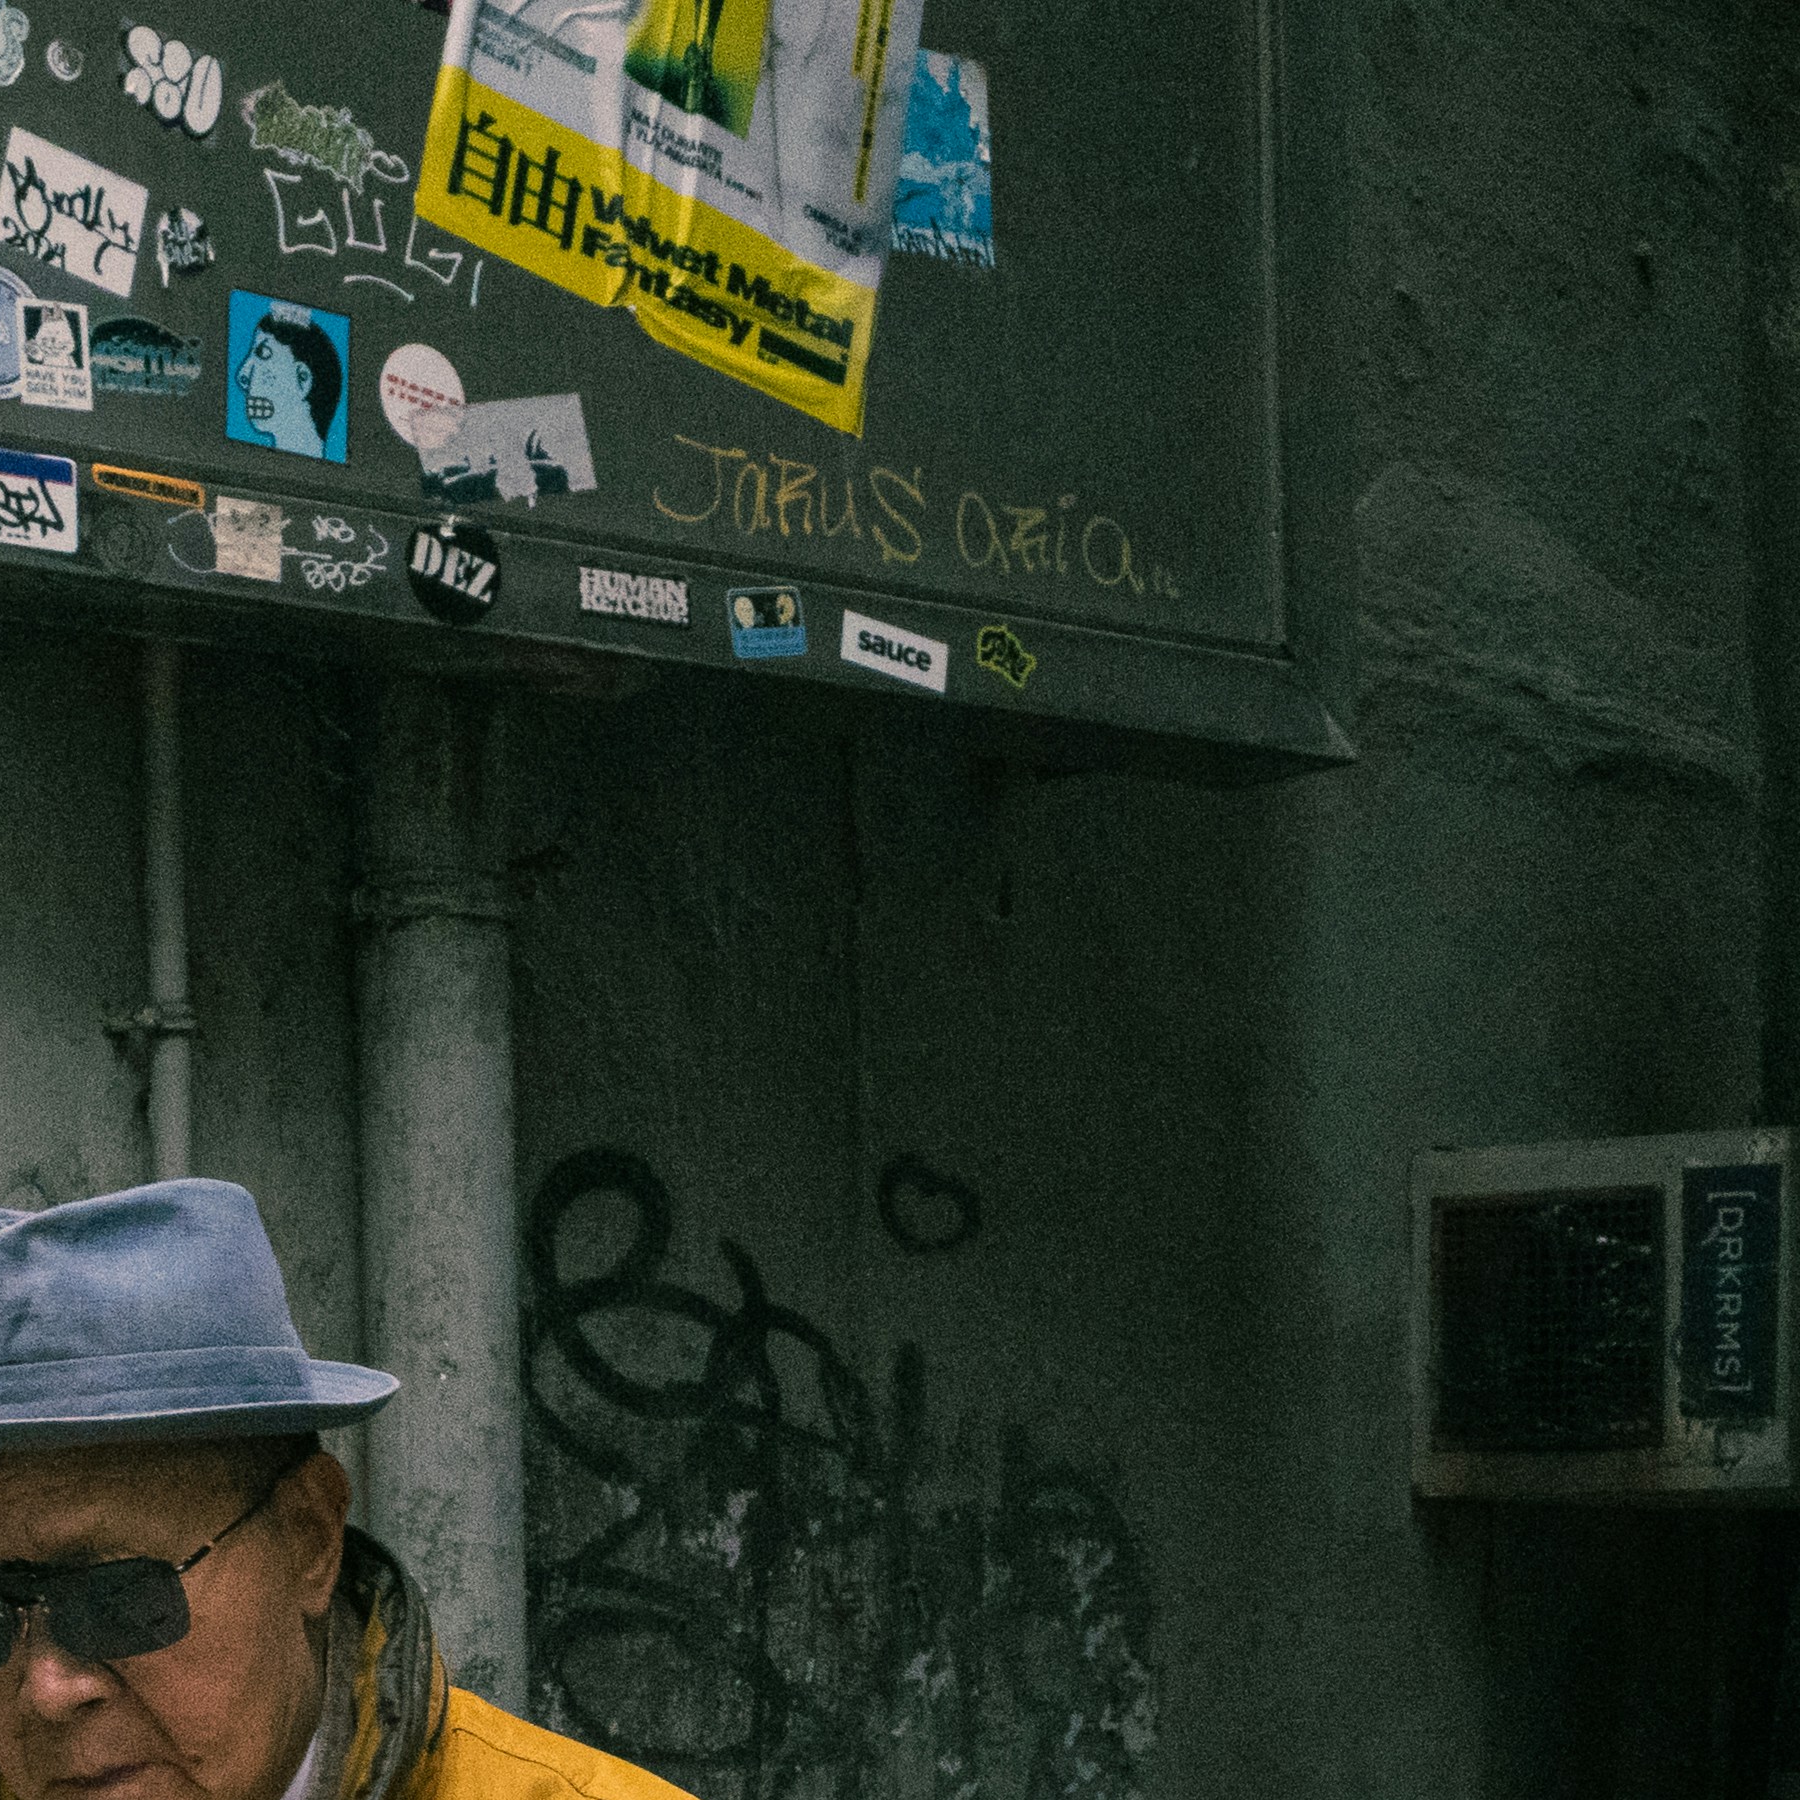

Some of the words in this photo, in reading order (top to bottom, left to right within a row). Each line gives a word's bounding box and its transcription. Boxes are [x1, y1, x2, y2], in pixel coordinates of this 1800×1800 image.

[447, 111, 583, 253] 自由
[581, 223, 753, 347] Fantasy
[727, 262, 853, 349] Metal
[27, 381, 58, 396] SEEN
[64, 387, 88, 399] HIM
[62, 372, 88, 386] YOU
[410, 531, 497, 603] DEZ
[579, 566, 688, 602] HUMAN
[857, 625, 932, 673] sauce
